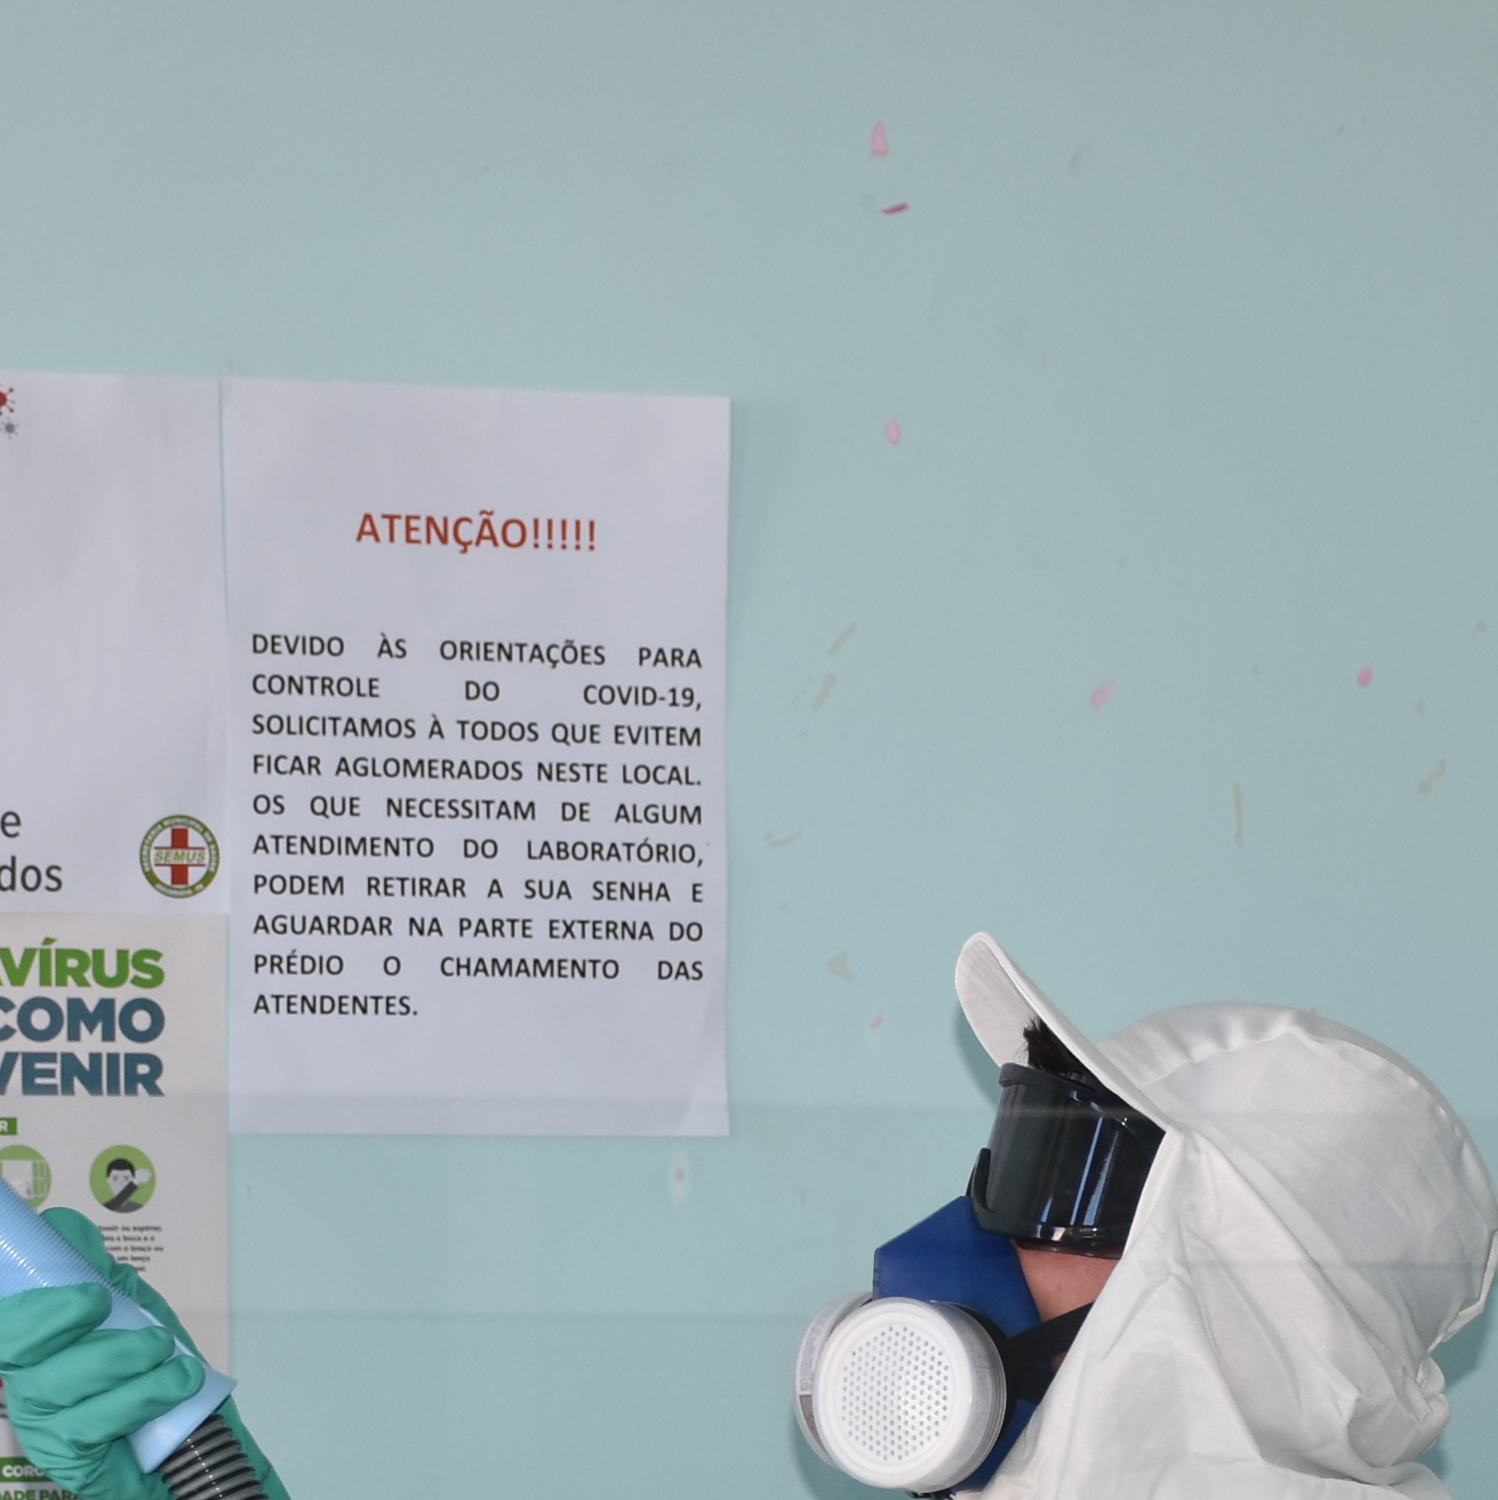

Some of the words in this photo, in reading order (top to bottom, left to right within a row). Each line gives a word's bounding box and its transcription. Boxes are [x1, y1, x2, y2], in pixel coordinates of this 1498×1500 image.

[356, 509, 597, 554] ATENÇÃO!!!!!
[253, 633, 344, 657] DEVIDO
[377, 633, 408, 659] ÀS
[440, 639, 606, 669] ORIENTAÇÕES
[639, 647, 703, 668] PARA
[252, 674, 380, 698] CONTROLE
[464, 680, 501, 701] DO
[583, 684, 703, 712] COVID-19,
[252, 714, 417, 738] SOLICITAMOS
[428, 714, 445, 739] À
[457, 719, 539, 742] TODOS
[551, 722, 601, 747] QUE
[613, 725, 702, 747] EVITEM
[253, 754, 322, 776] FICAR
[335, 756, 524, 782] AGLOMERADOS
[537, 761, 609, 784] NESTE
[622, 764, 702, 787] LOCAL.
[0, 811, 22, 839] e
[253, 794, 286, 816] OS
[309, 796, 361, 820] QUE
[386, 797, 537, 822] NECESSITAM
[561, 801, 591, 823] DE
[615, 803, 703, 825] ALGUM
[154, 849, 207, 863] SEMUS
[253, 834, 435, 859] ATENDIMENTO
[463, 838, 499, 860] DO
[527, 837, 704, 867] LABORATÓRIO,
[253, 874, 345, 896] PODEM
[367, 876, 468, 899] RETIRAR
[487, 878, 504, 900] A
[524, 879, 573, 901] SUA
[592, 880, 672, 903] SENHA
[691, 882, 704, 904] E
[253, 914, 394, 937] AGUARDAR
[408, 917, 444, 938] NA
[458, 918, 534, 940] PARTE
[548, 918, 655, 942] EXTERNA
[669, 921, 704, 943] DO
[253, 948, 345, 976] PRÉDIO
[382, 954, 402, 976] O
[440, 956, 621, 981] CHAMAMENTO
[657, 959, 704, 981] DAS
[253, 994, 419, 1017] ATENDENTES.
